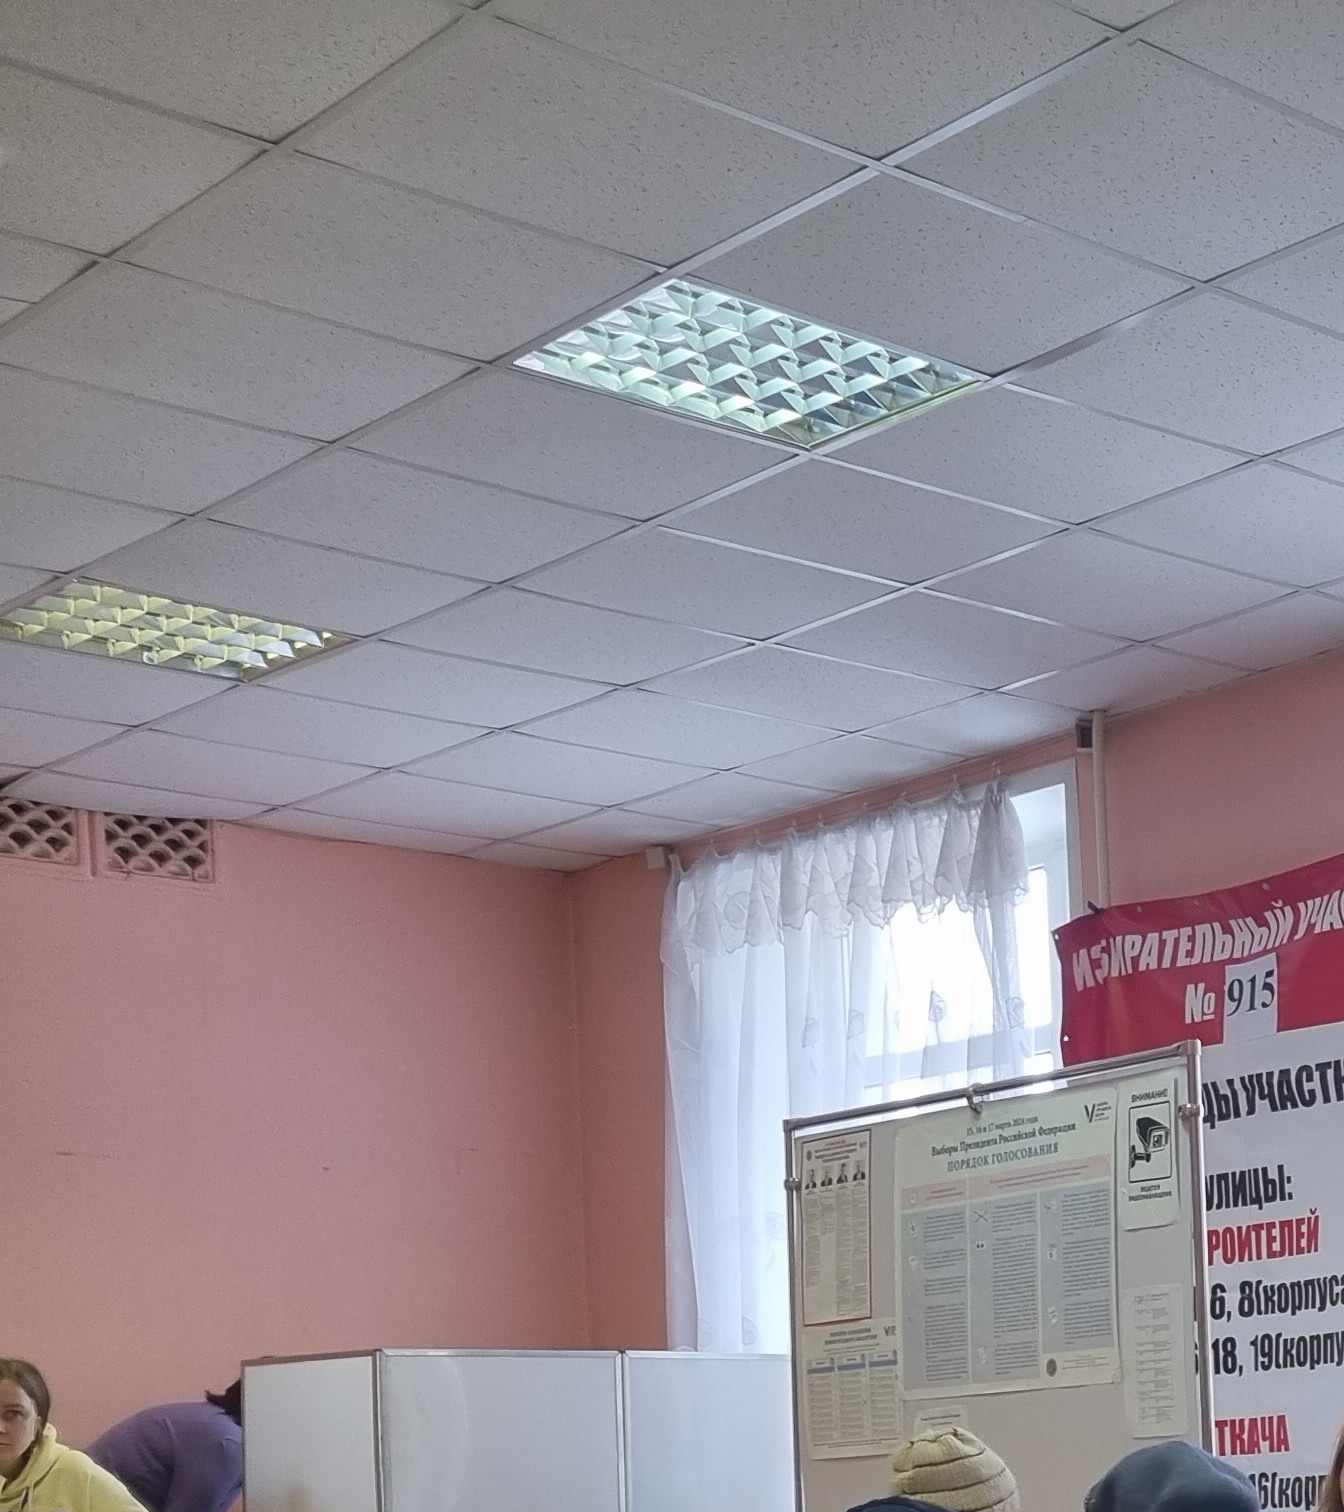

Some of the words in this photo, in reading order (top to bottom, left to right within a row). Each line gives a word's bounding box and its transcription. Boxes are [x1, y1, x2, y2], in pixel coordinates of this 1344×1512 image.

[1184, 982, 1216, 1025] №
[1225, 968, 1276, 1018] 915
[1209, 1282, 1232, 1324] 6,
[1210, 1336, 1244, 1377] 18,
[1215, 1414, 1291, 1457] ТКАЧА
